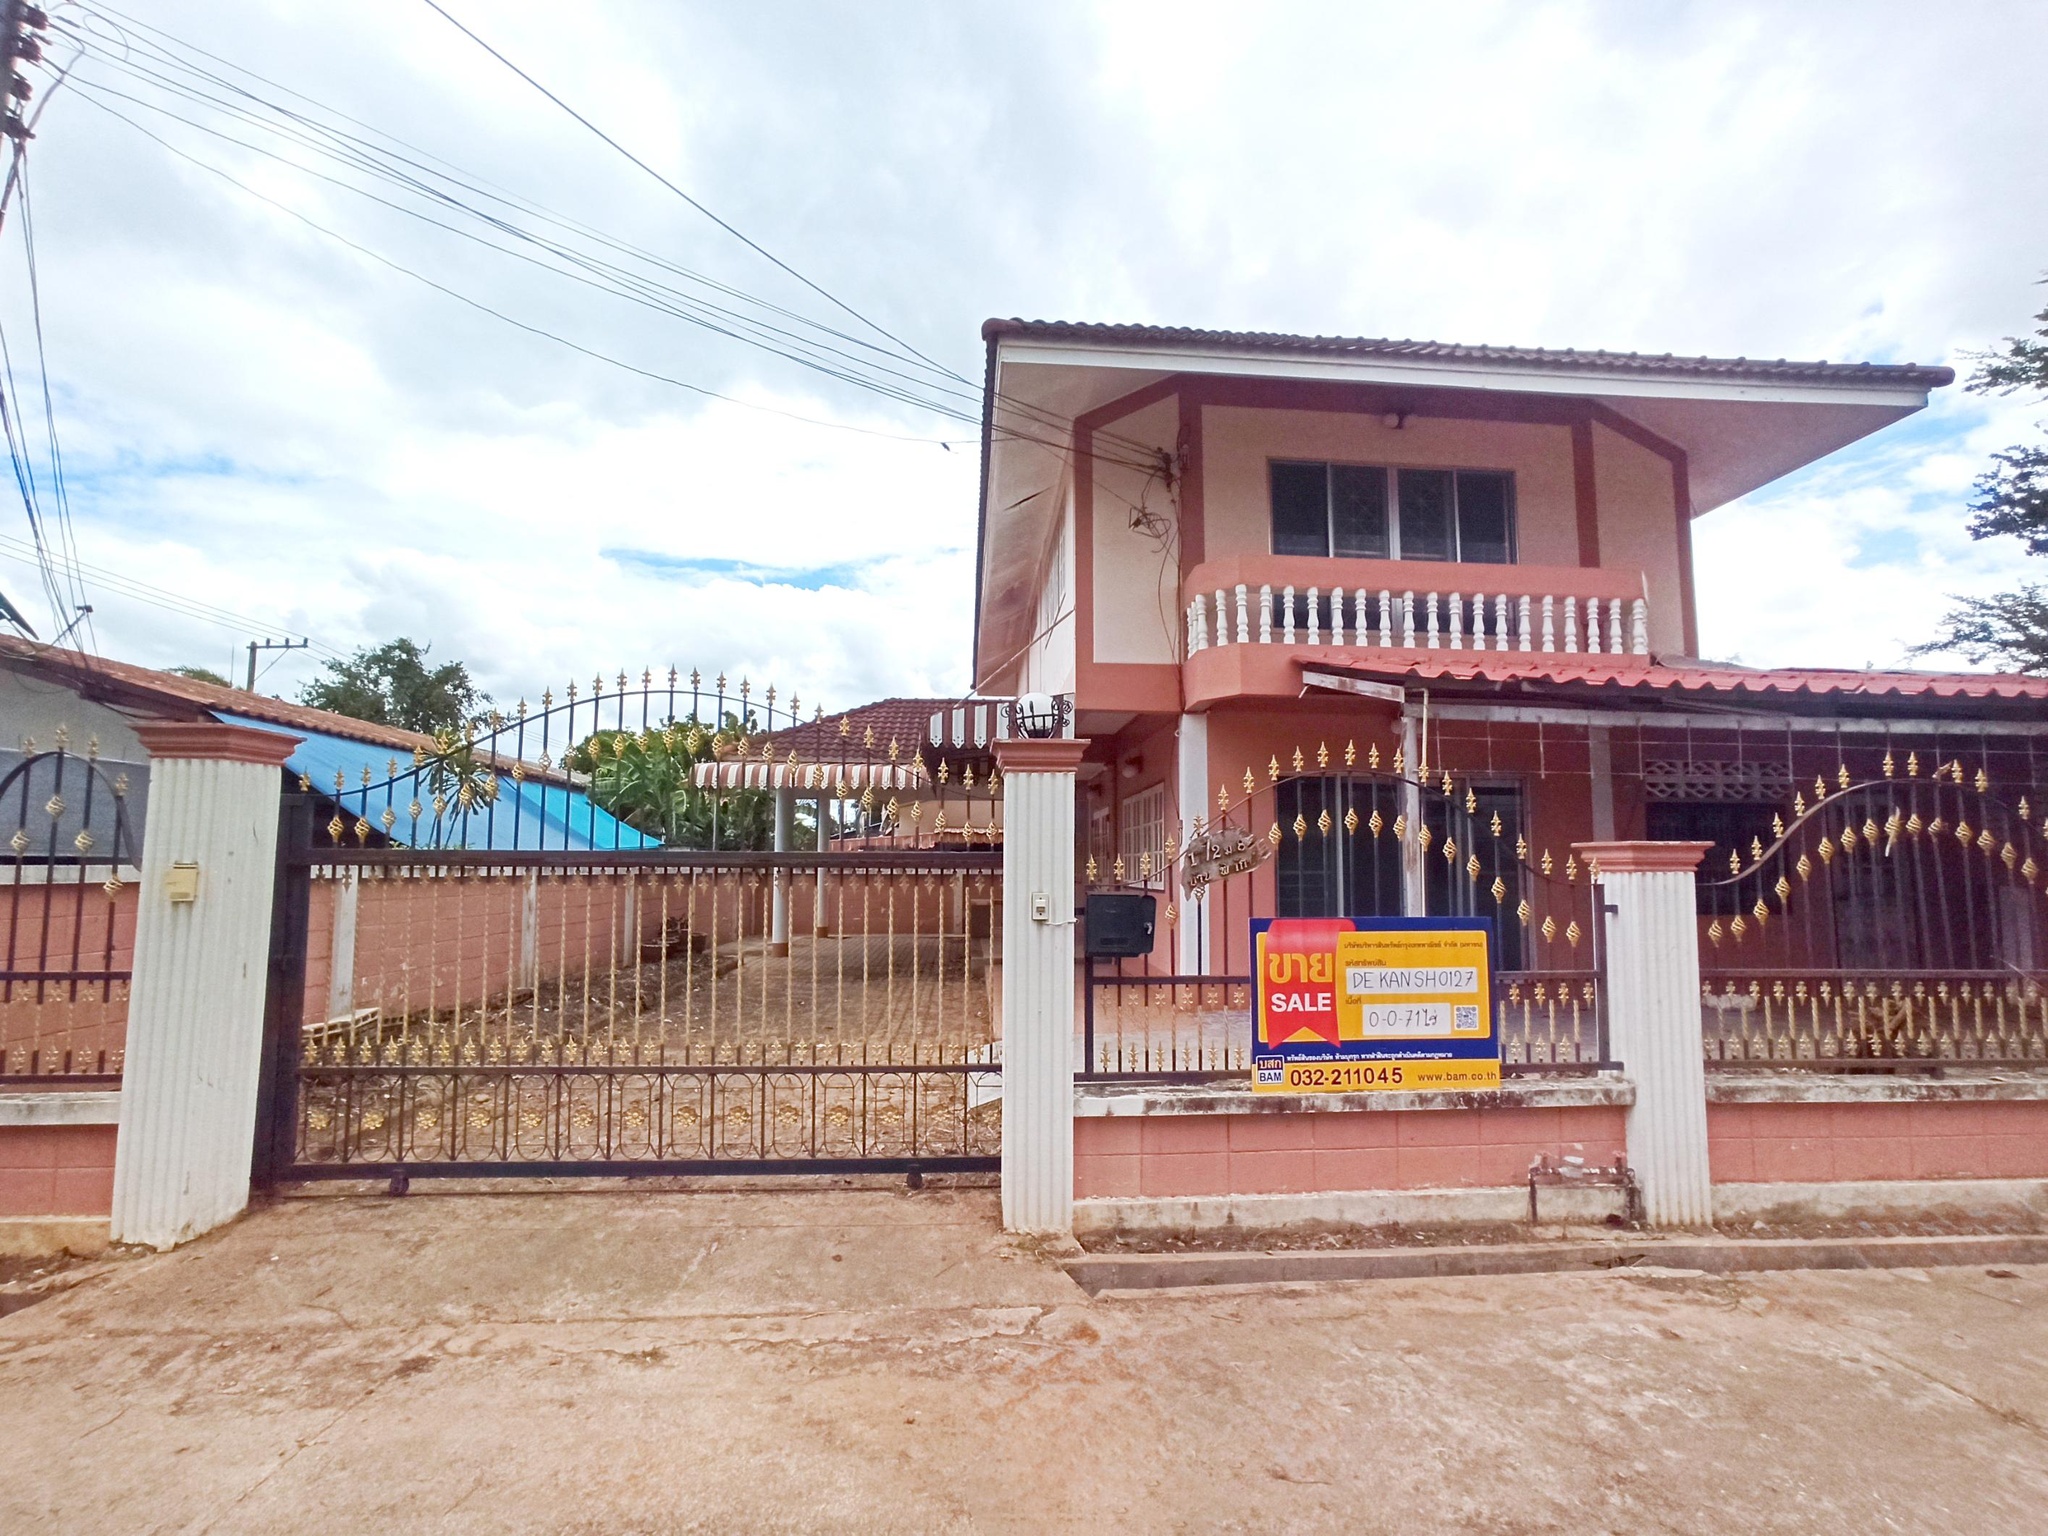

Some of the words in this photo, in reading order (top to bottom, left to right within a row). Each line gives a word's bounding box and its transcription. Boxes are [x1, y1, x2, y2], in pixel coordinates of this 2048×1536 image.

[1269, 953, 1333, 984] ขาย
[1271, 993, 1332, 1012] SALE
[1259, 1060, 1281, 1069] บสก
[1260, 1072, 1281, 1082] BAM
[1417, 1071, 1497, 1082] www.bam.co.th
